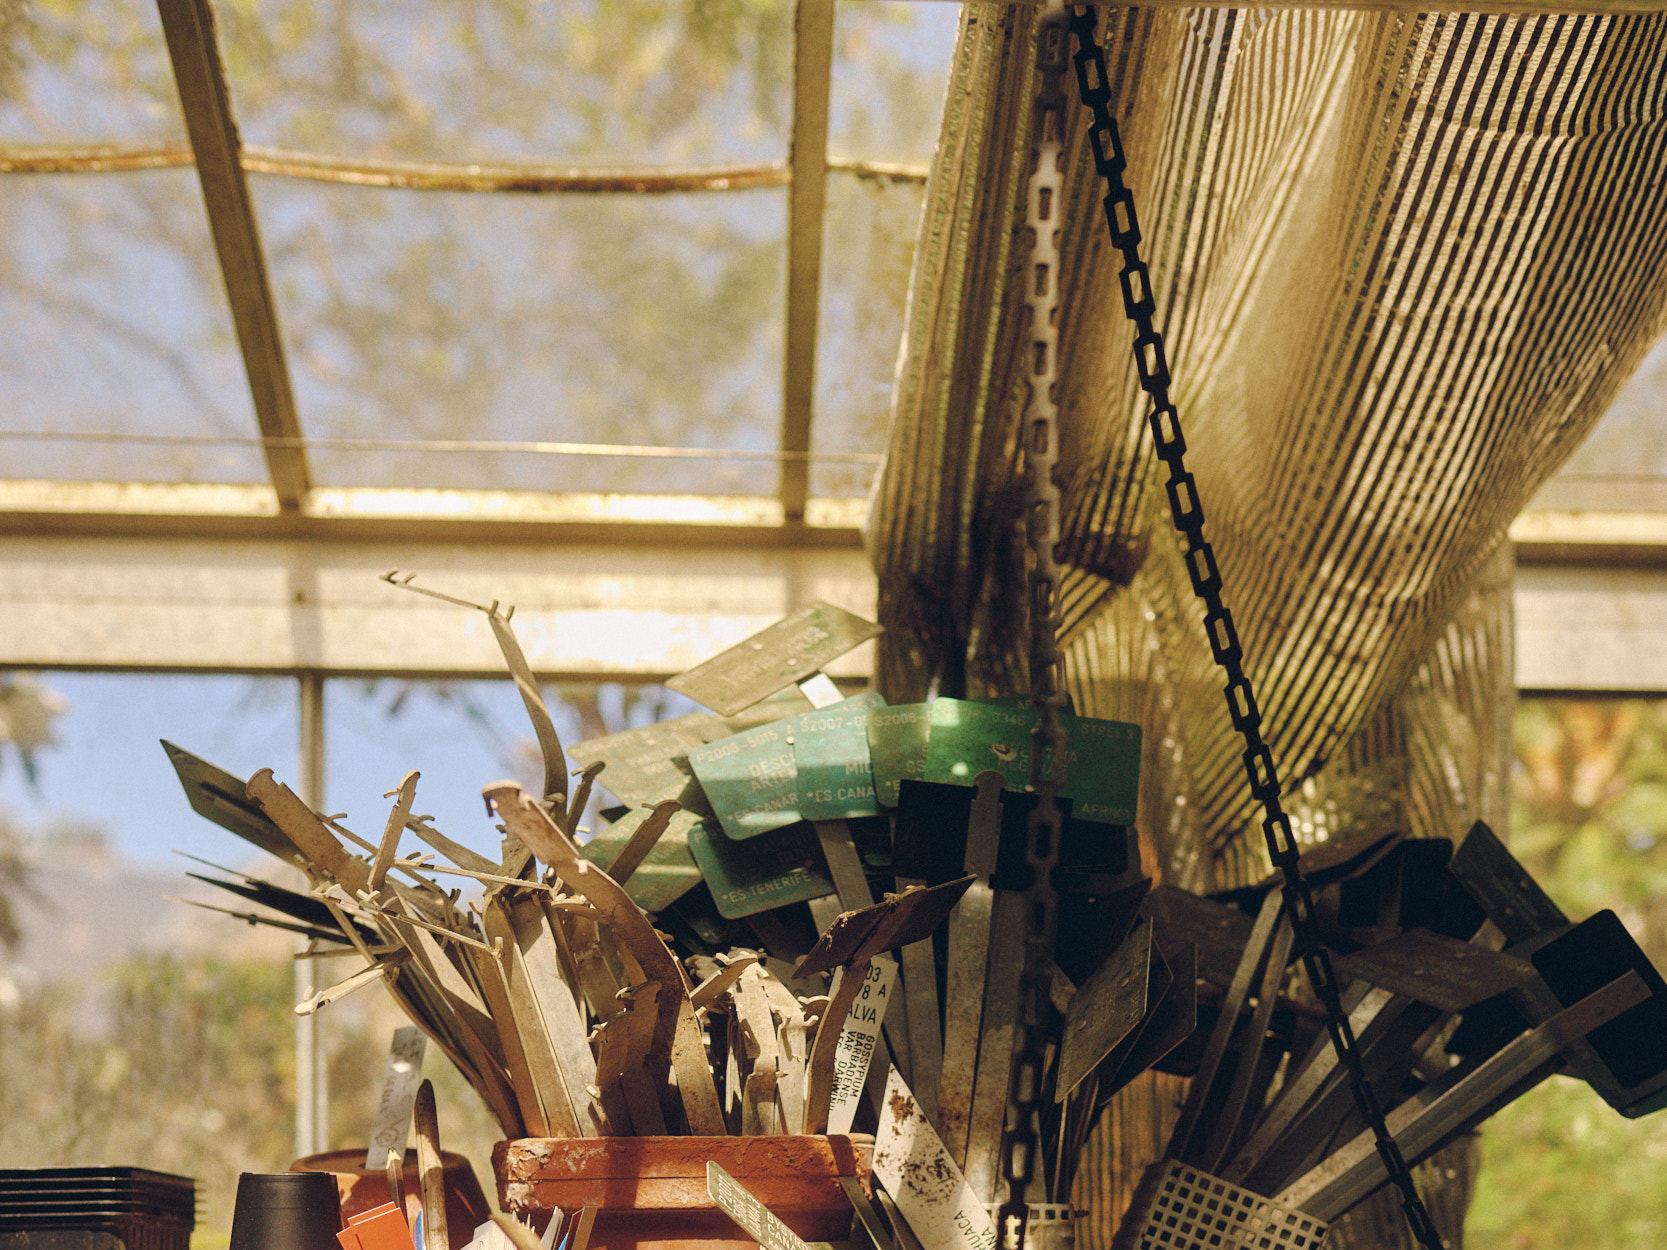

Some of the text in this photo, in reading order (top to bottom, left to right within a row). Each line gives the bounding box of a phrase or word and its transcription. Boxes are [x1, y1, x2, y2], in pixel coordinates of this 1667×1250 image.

[878, 983, 887, 998] A
[837, 1031, 867, 1107] BARBADENSE
[850, 1034, 876, 1099] GOSSYPIUM
